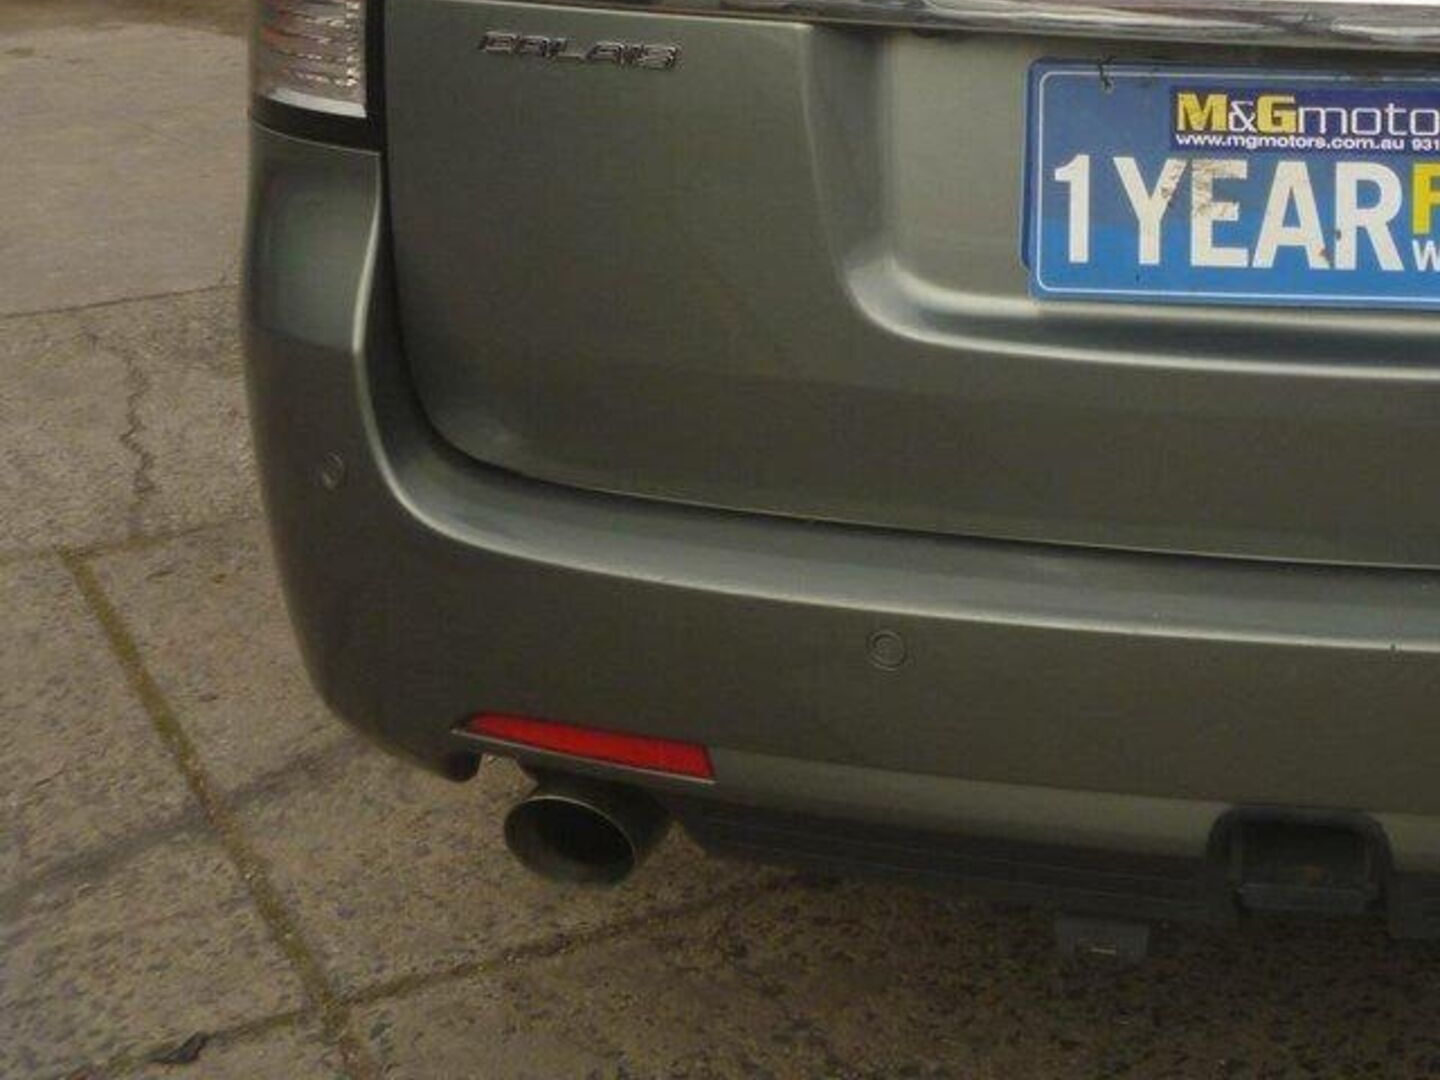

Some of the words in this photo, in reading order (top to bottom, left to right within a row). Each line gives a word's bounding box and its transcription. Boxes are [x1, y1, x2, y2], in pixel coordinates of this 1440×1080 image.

[1175, 133, 1405, 151] www.mgmotors.com.au
[1053, 154, 1090, 264] 1
[1113, 155, 1406, 272] YEAR
